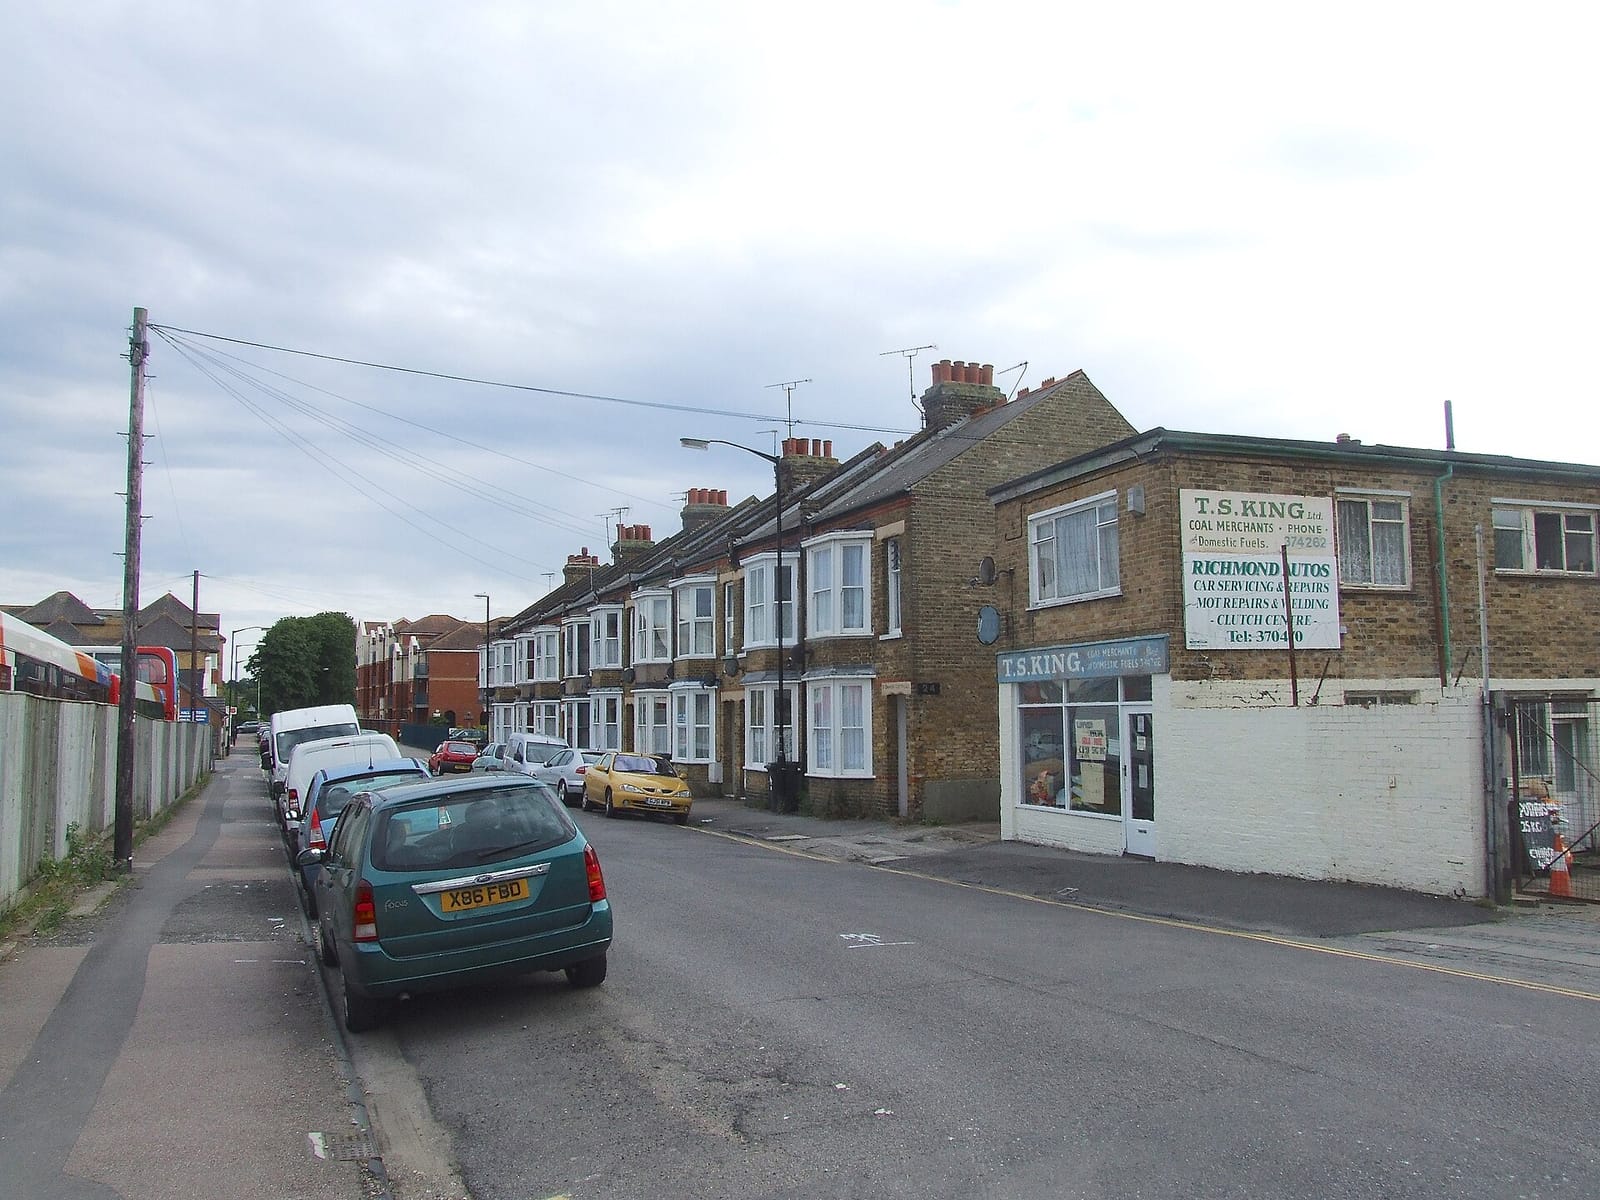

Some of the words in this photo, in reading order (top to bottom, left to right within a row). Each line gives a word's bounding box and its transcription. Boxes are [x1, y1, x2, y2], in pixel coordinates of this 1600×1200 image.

[1189, 519, 1213, 531] COAL
[1216, 520, 1274, 533] MERCHANTS
[1287, 523, 1322, 534] PHONE
[1198, 535, 1237, 548] Domestic
[1284, 535, 1327, 549] 374262
[1191, 560, 1280, 576] RICHMOND
[1193, 579, 1215, 592] CAR
[1217, 580, 1274, 592] SERVICING
[1276, 581, 1284, 593] &
[1196, 597, 1222, 609] MOT
[1223, 597, 1269, 609] REPAIRS
[1271, 598, 1279, 609] &
[1217, 613, 1264, 626] CLUTCH
[1226, 630, 1252, 643] Tel:
[1255, 630, 1303, 643] 37040
[450, 889, 484, 908] X86
[487, 881, 521, 901] FBD
